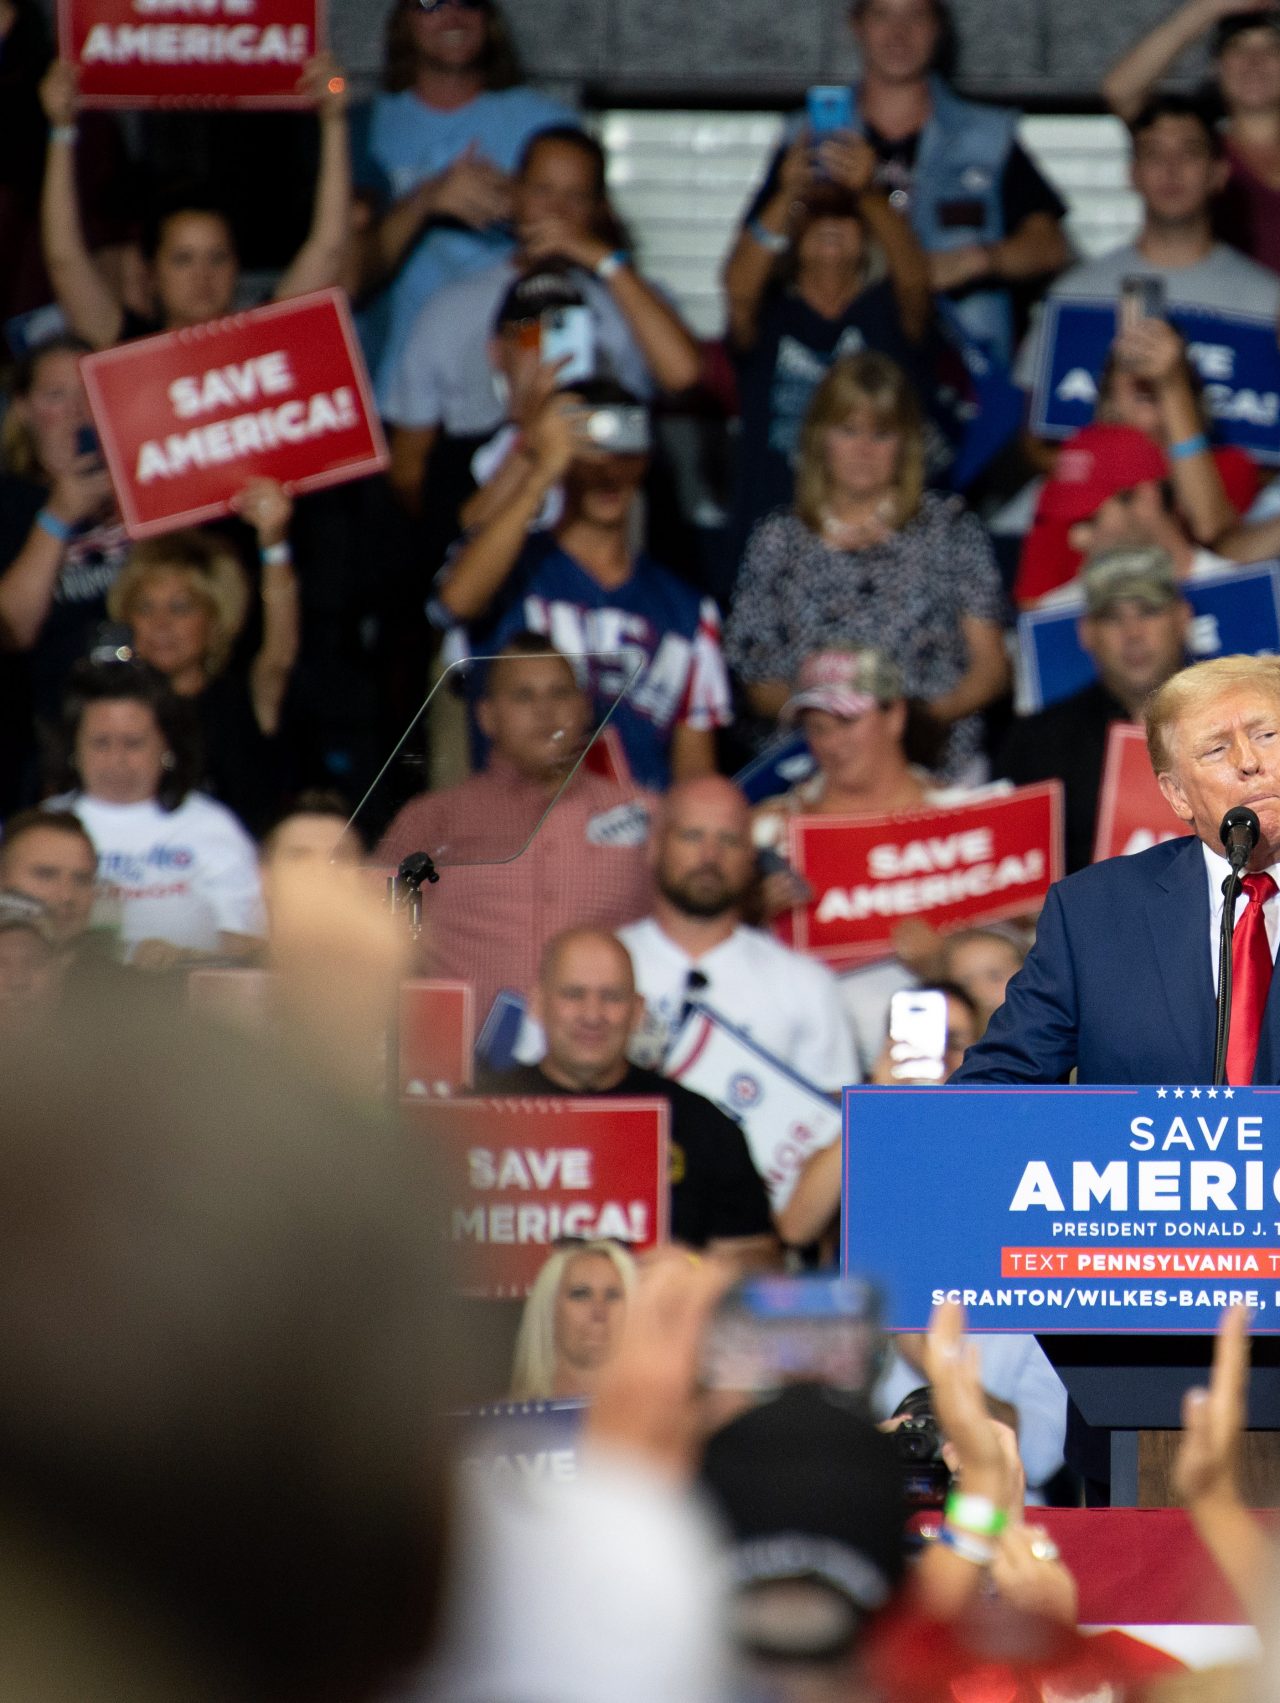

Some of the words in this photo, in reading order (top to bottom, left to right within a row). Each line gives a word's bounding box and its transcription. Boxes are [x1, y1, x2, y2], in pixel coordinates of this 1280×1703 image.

[80, 23, 309, 64] AMERICA!
[168, 350, 296, 420] SAVE
[135, 385, 359, 486] AMERICA!
[866, 826, 995, 881] SAVE
[815, 846, 1046, 924] AMERICA!
[1129, 1115, 1264, 1152] SAVE
[467, 1147, 593, 1191] SAVE
[1052, 1221, 1158, 1237] PRESIDENT
[1164, 1221, 1246, 1237] DONALD
[1252, 1221, 1267, 1237] J.
[1009, 1253, 1069, 1272] TEXT
[1076, 1254, 1260, 1272] PENNSYLVANIA
[931, 1287, 1266, 1310] SCRANTON/WILKES-BARRE,
